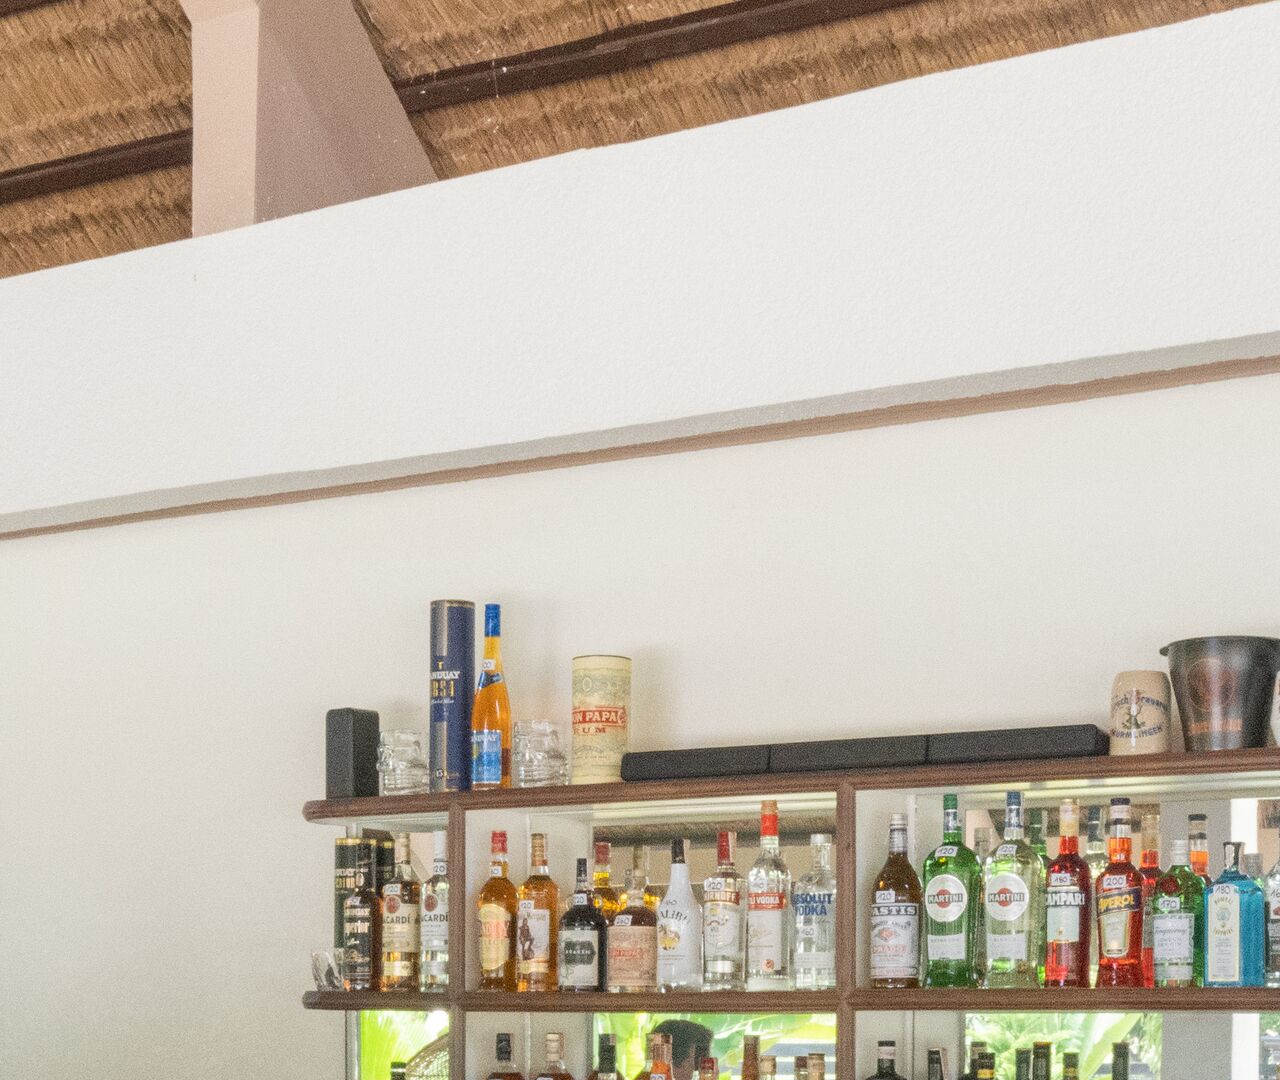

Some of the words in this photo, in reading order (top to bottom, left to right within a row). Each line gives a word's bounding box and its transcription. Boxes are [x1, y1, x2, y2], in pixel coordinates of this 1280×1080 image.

[585, 709, 617, 723] PAPA
[1106, 876, 1123, 886] 200
[928, 893, 963, 904] MARTINI
[988, 893, 1024, 904] MARTINI
[872, 905, 916, 916] ASTIS
